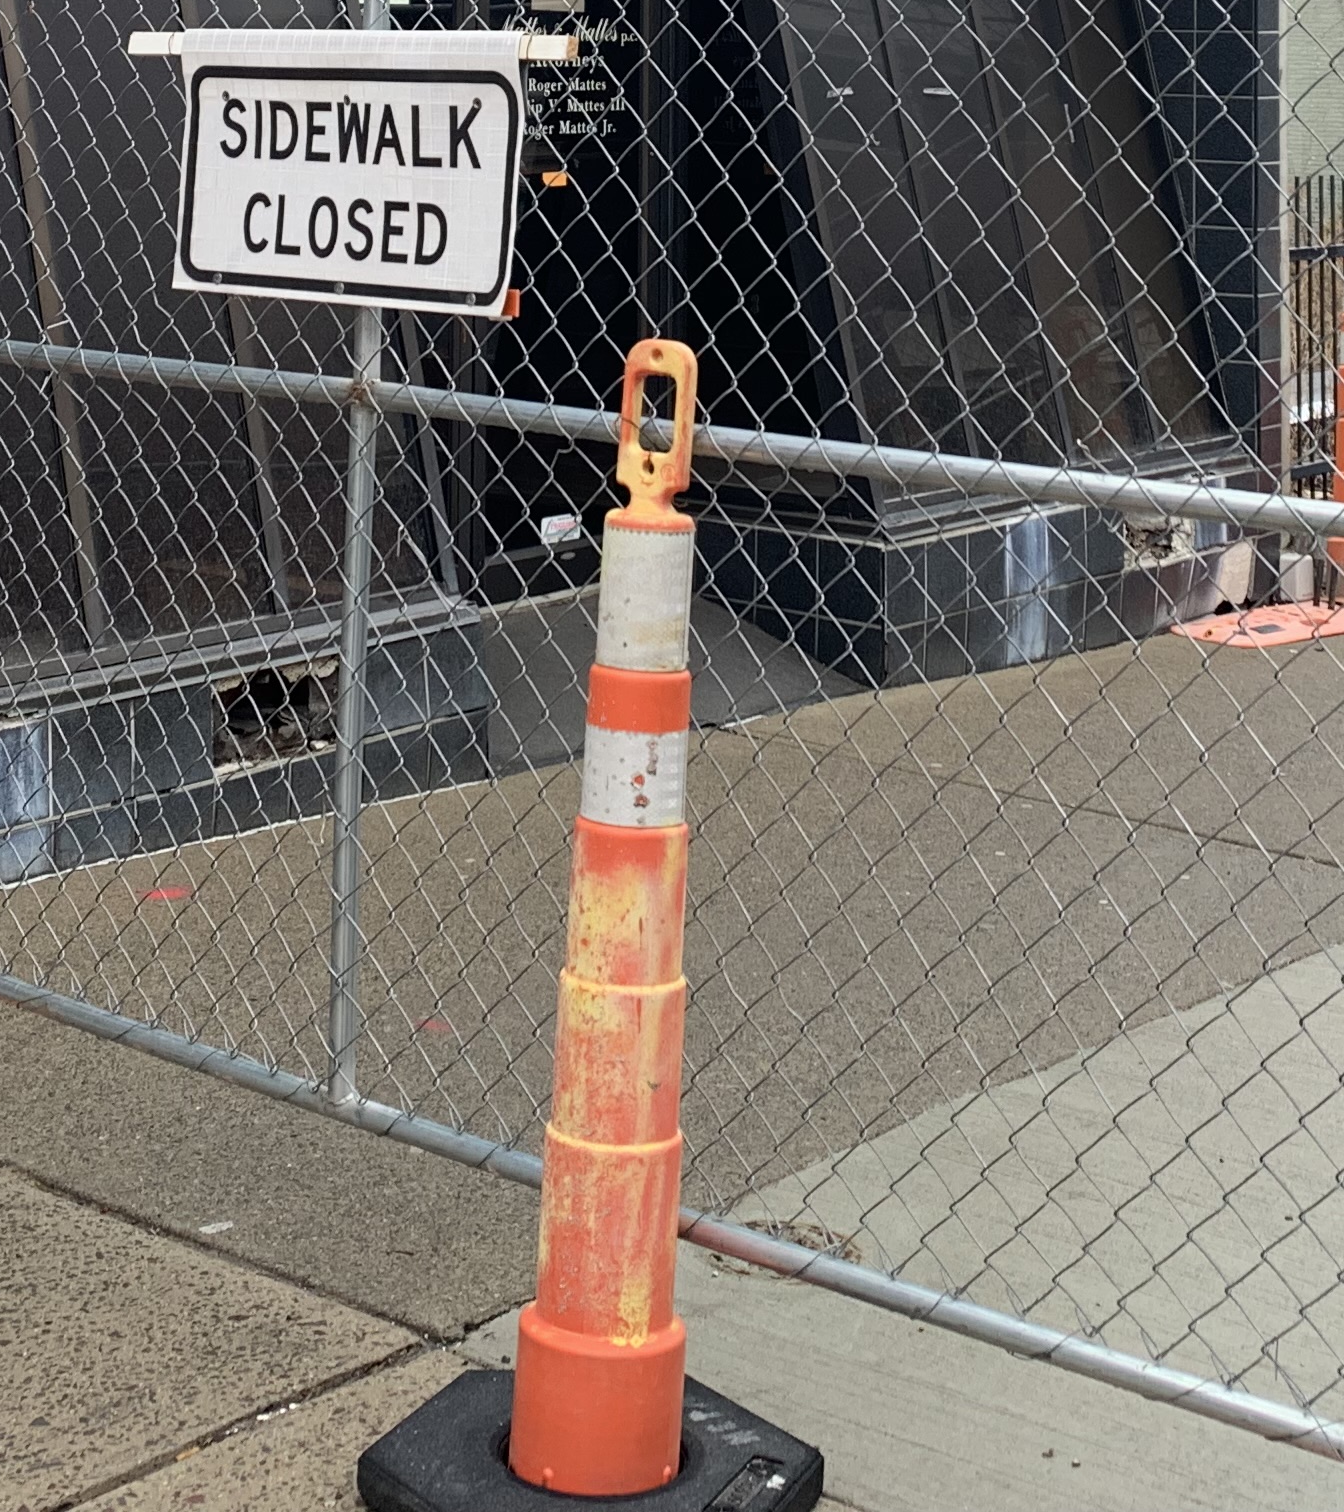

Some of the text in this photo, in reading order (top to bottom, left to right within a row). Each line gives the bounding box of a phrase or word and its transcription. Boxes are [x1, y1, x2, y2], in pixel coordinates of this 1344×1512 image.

[573, 15, 618, 42] Mattes
[528, 78, 607, 97] Roger Mattes
[567, 98, 605, 113] Mattes
[220, 96, 482, 170] SIDEWALK
[559, 120, 597, 134] Mattes
[600, 119, 617, 138] Jr.
[243, 191, 448, 266] CLOSED
